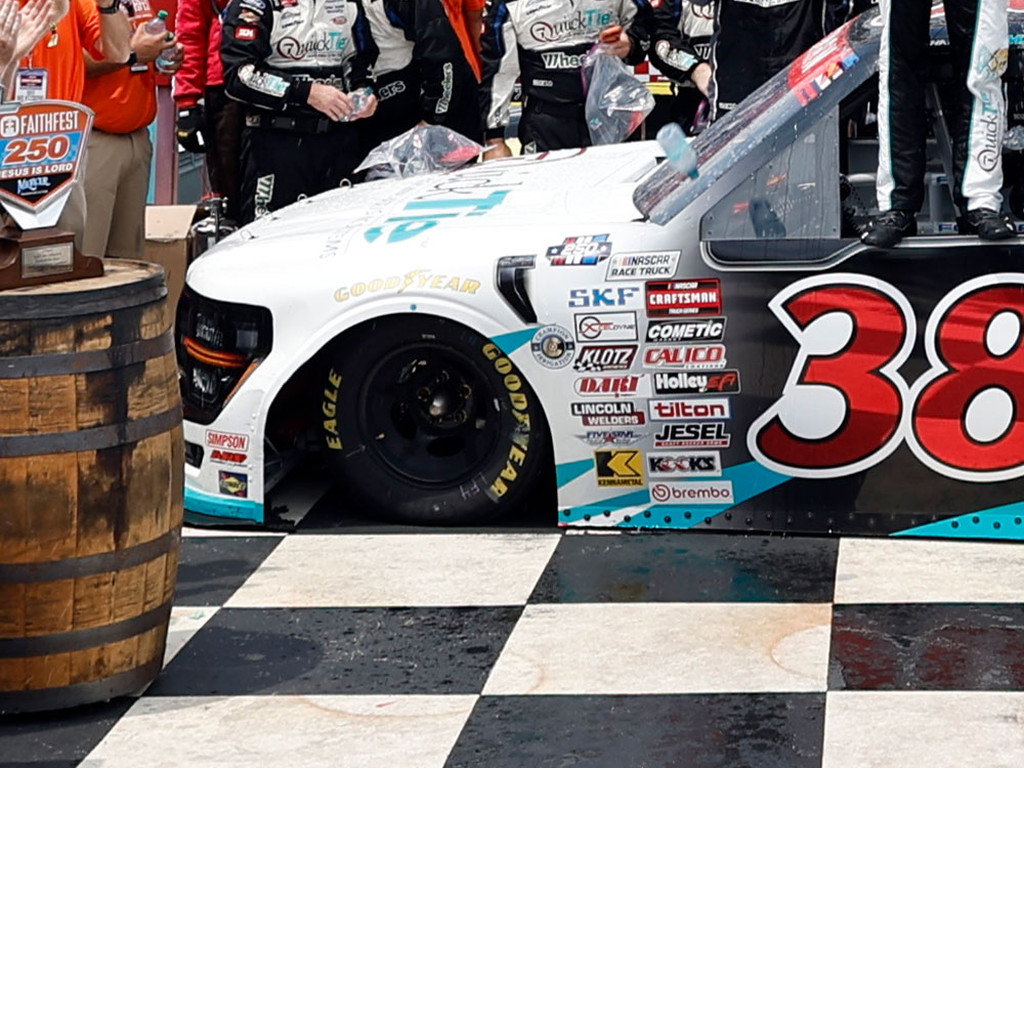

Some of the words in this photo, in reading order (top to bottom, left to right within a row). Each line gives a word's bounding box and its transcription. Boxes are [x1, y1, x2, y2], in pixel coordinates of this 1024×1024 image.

[530, 8, 613, 44] QuickTie
[277, 31, 347, 61] QuickTie
[20, 110, 79, 134] FAITHFEST
[3, 135, 70, 165] 250
[0, 168, 29, 177] ESUS
[32, 166, 42, 175] IS
[45, 163, 73, 173] LORD
[561, 241, 600, 258] 250
[631, 255, 671, 266] NASCAR
[611, 267, 636, 277] RACE
[640, 266, 672, 275] TRUCK
[334, 270, 481, 302] GOODYEAR
[568, 287, 640, 308] SKF
[649, 291, 718, 305] CRAFTSMAN
[649, 320, 723, 339] COMETIC
[582, 348, 634, 365] KLOTZ
[645, 346, 724, 365] CALICO
[656, 374, 707, 392] Holley
[322, 368, 343, 450] EAGLE
[573, 404, 632, 415] LINCOLN
[654, 402, 725, 417] tilton
[587, 416, 639, 425] WELDERS
[208, 432, 246, 449] SIMPSON
[655, 425, 729, 440] JESEL
[598, 478, 644, 487] KENNAMETAL
[672, 486, 730, 498] brembo
